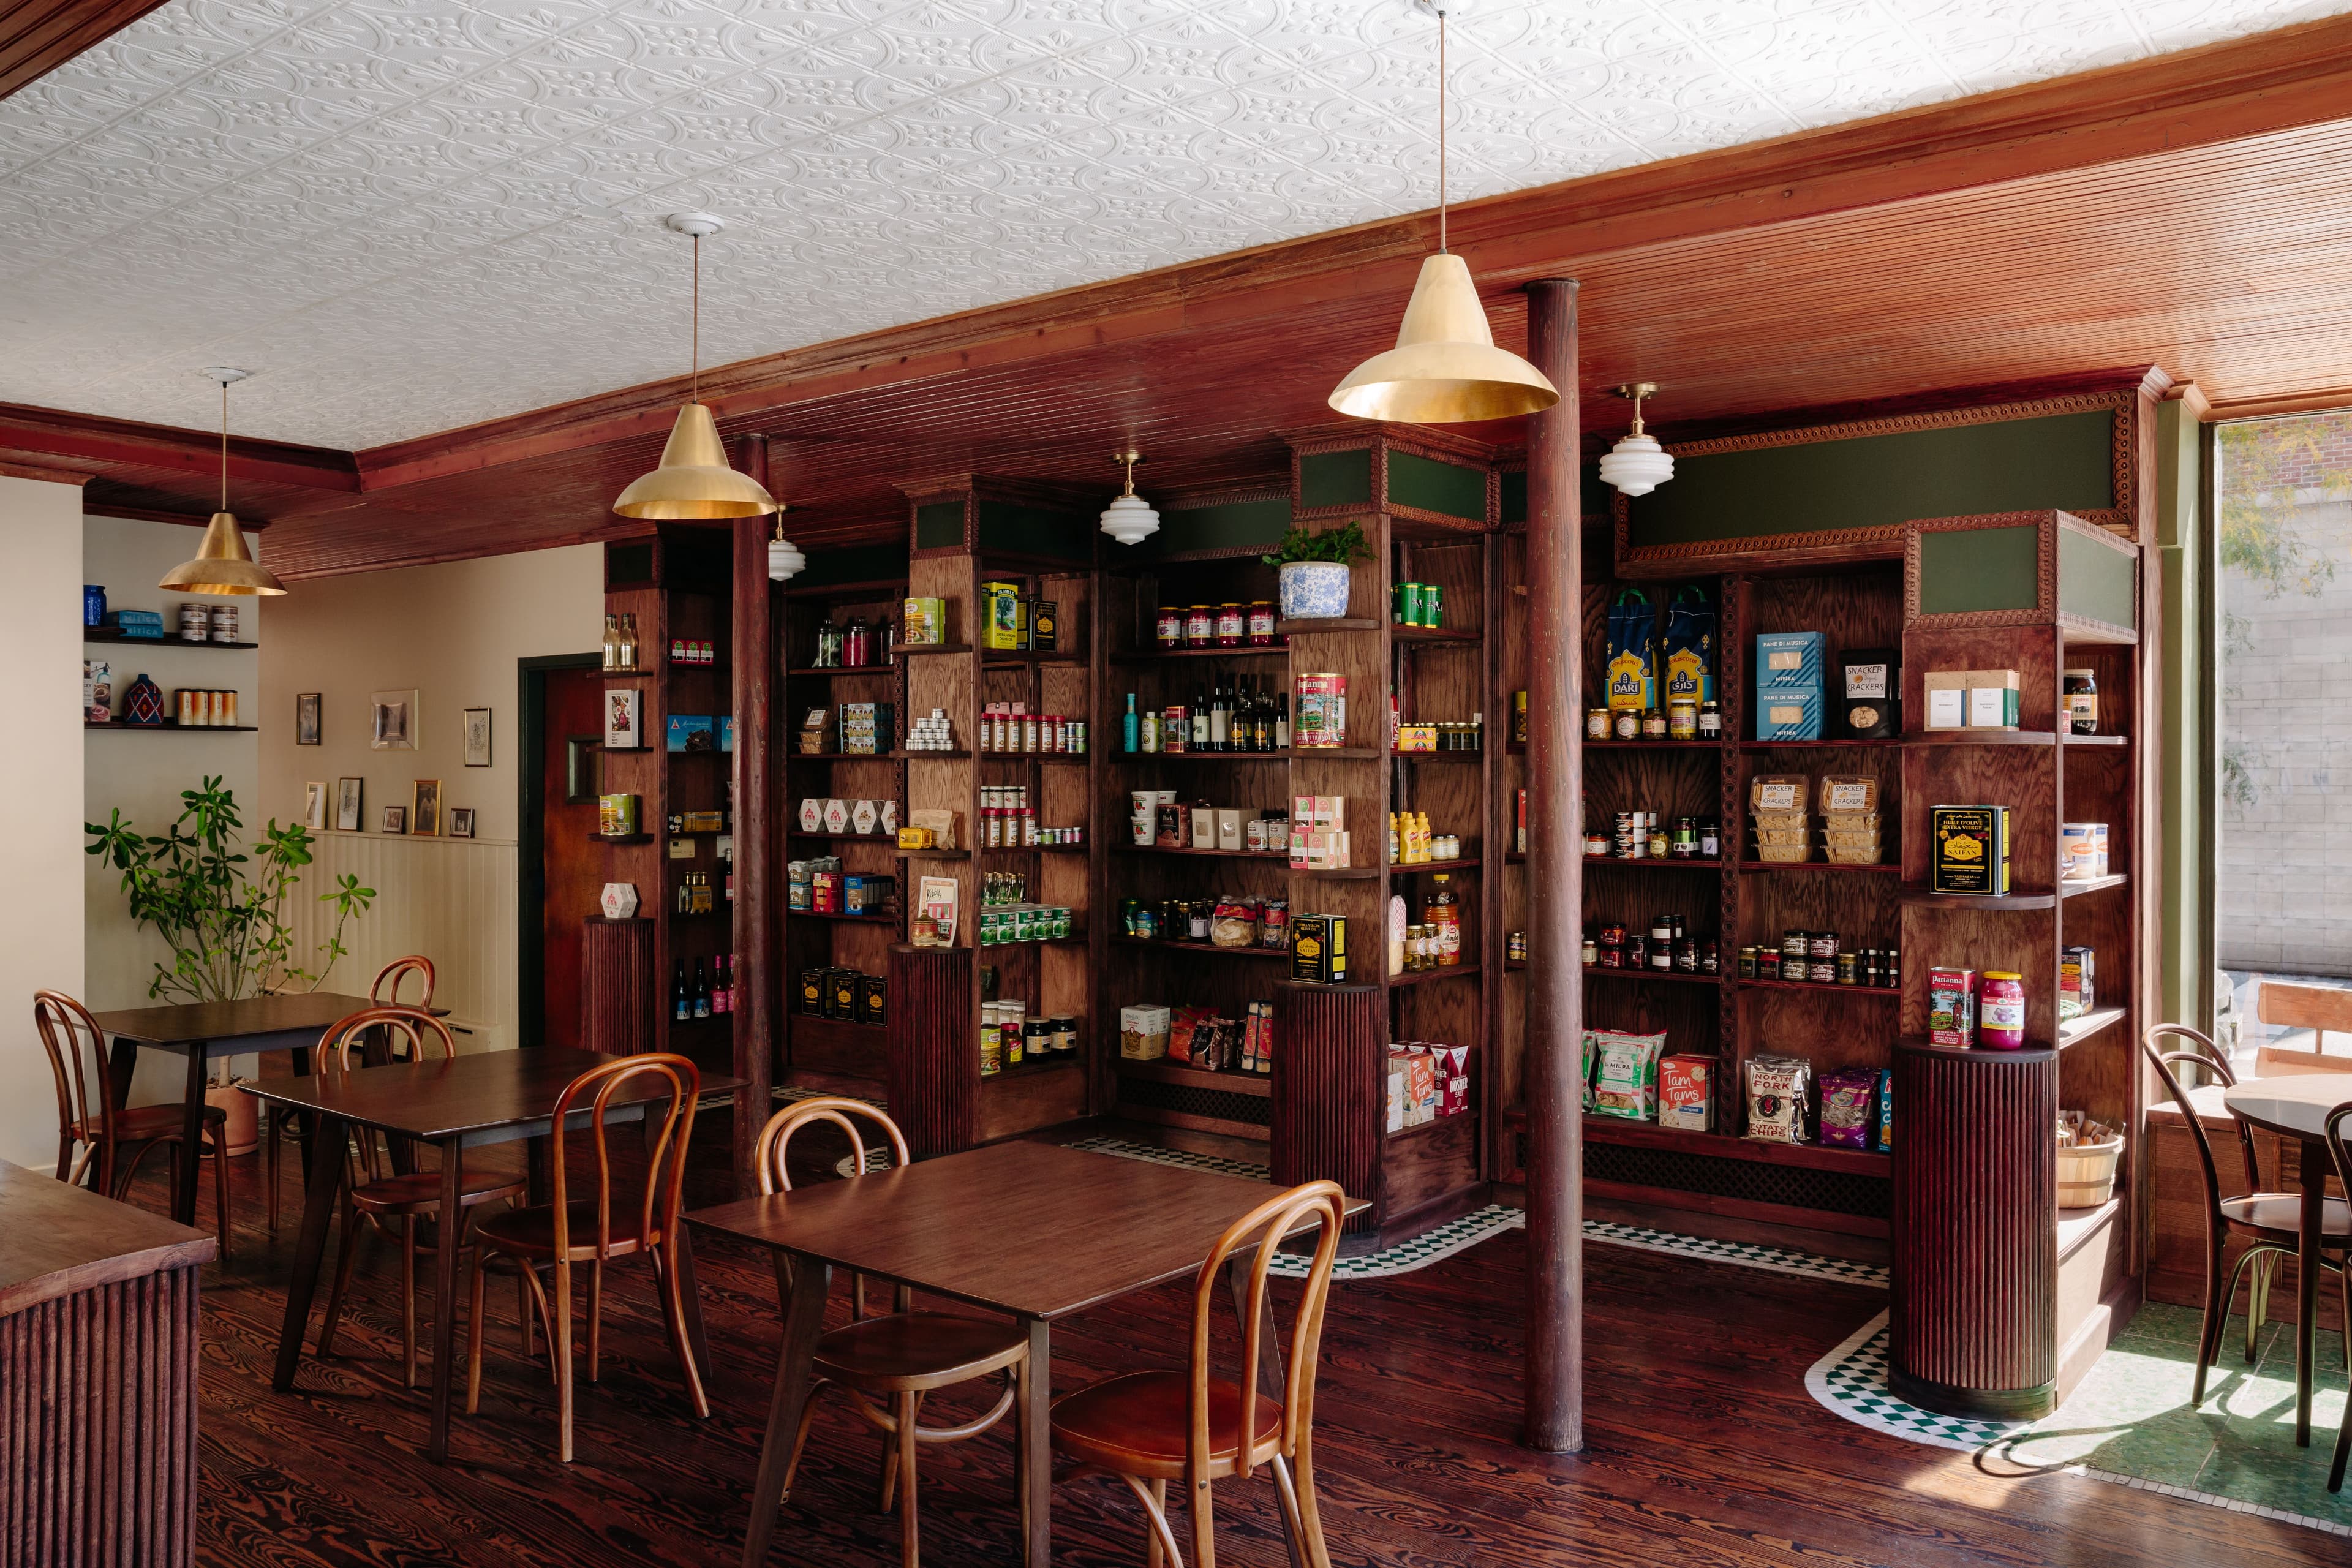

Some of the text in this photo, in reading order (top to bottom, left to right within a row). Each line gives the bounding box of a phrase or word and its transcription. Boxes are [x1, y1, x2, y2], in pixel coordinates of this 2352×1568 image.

[1848, 666, 1882, 674] SNACKER
[1614, 684, 1638, 693] DARI
[1847, 683, 1884, 692] CRACKERS
[1932, 975, 1963, 984] Partanna
[1412, 1066, 1430, 1084] Tam
[1434, 1070, 1447, 1079] OSHER
[1664, 1070, 1694, 1088] Tam
[1755, 1073, 1792, 1082] NORTH
[1415, 1080, 1433, 1099] Tams
[1450, 1077, 1468, 1093] KOSHER
[1753, 1080, 1790, 1091] FORK
[1666, 1086, 1700, 1102] Tams
[1749, 1123, 1787, 1131] POTATO
[1750, 1128, 1786, 1137] CHIPS
